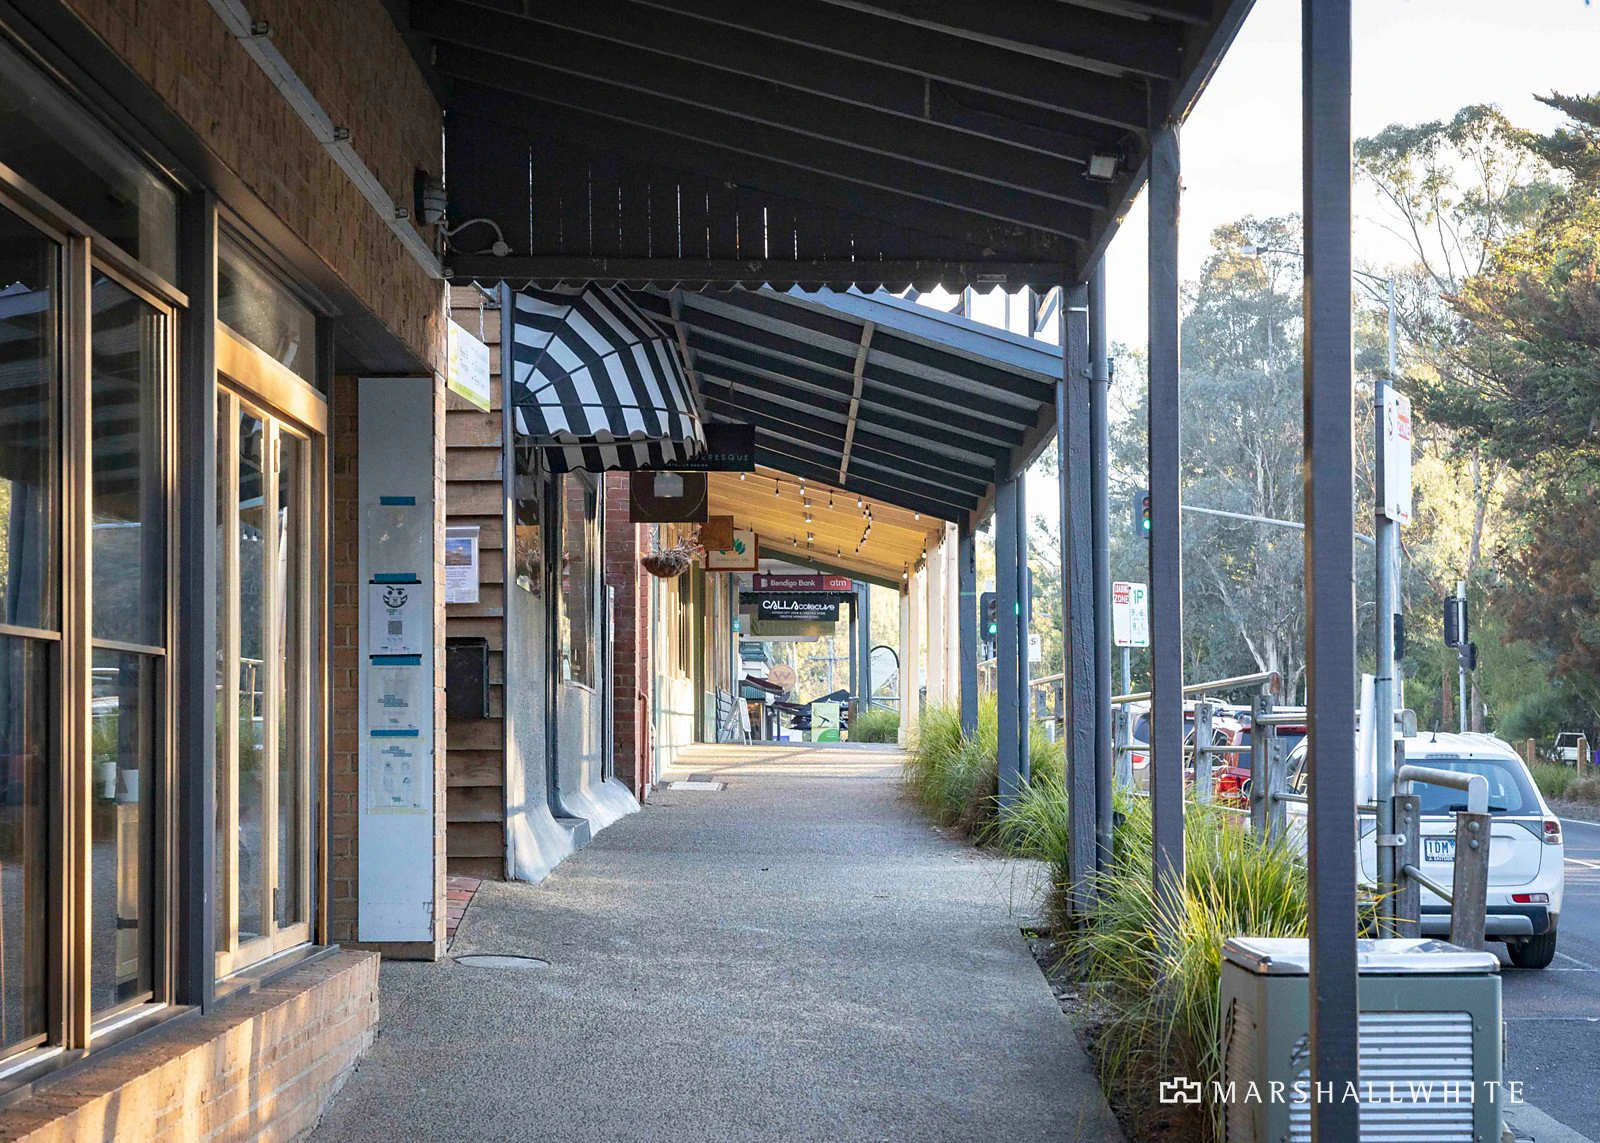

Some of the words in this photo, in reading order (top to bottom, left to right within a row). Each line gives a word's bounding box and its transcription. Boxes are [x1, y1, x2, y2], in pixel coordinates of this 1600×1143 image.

[770, 579, 797, 588] Bendigo
[798, 579, 816, 587] Bank
[1114, 595, 1129, 604] ZONE
[1133, 590, 1144, 605] 1P
